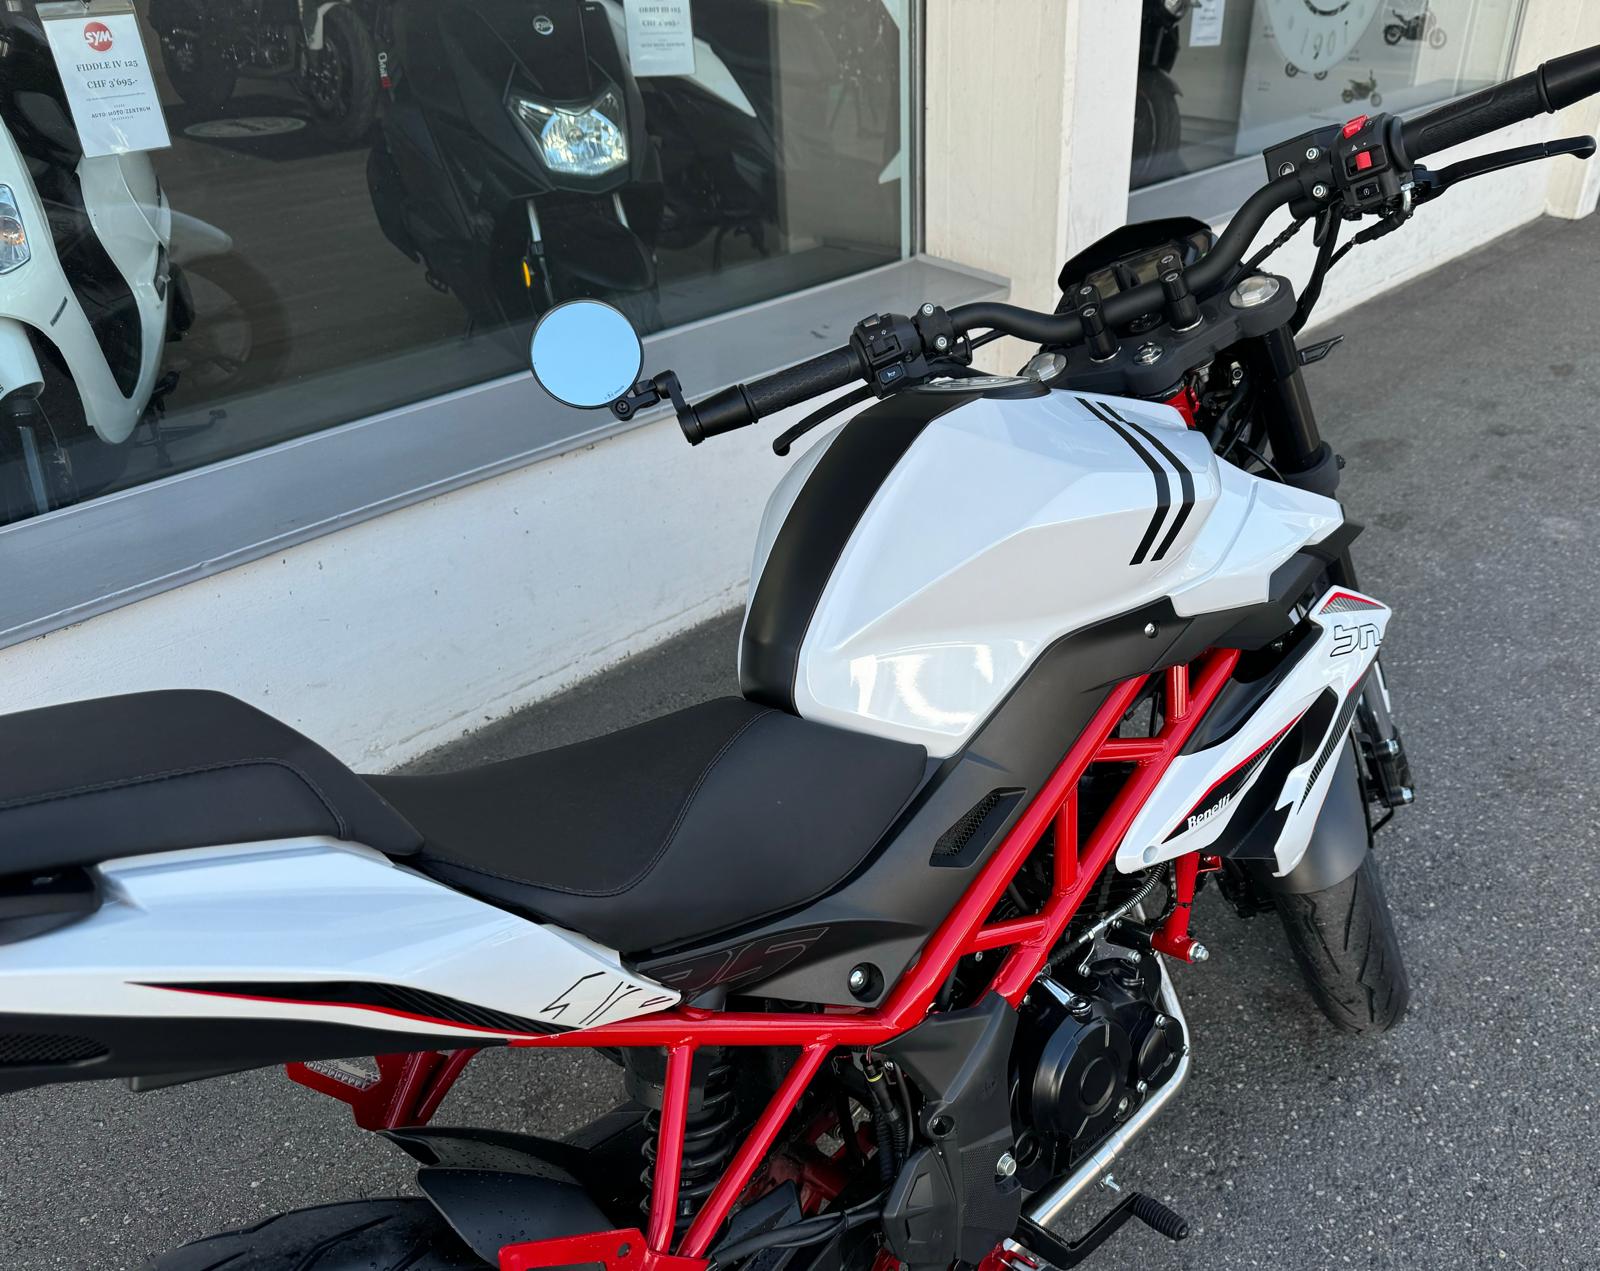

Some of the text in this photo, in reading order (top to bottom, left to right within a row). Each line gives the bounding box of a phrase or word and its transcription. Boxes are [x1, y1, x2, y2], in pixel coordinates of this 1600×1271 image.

[84, 31, 112, 46] SYM
[76, 62, 111, 72] FIDDLE
[124, 60, 138, 68] 125
[87, 80, 108, 89] CHF
[1186, 792, 1231, 830] Benelli
